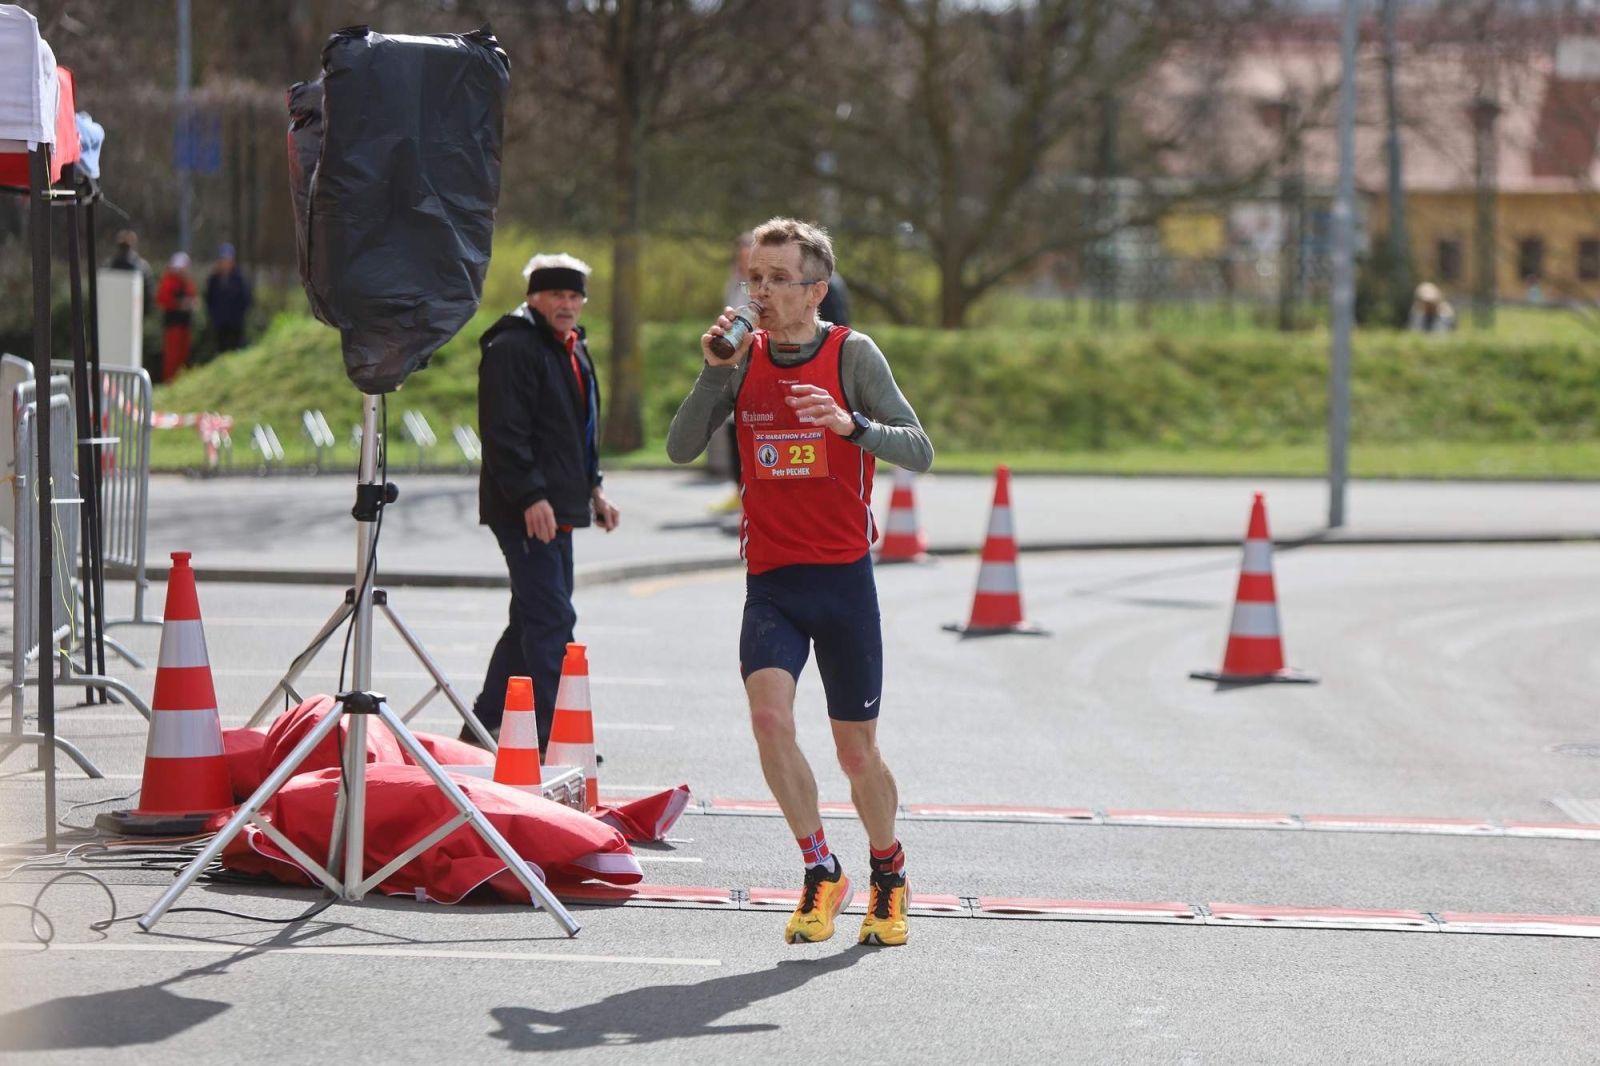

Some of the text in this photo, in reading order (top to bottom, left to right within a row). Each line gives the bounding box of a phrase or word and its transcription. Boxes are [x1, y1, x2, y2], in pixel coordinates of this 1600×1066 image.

[789, 445, 816, 464] 23
[772, 467, 810, 477] Petr PECHEK
